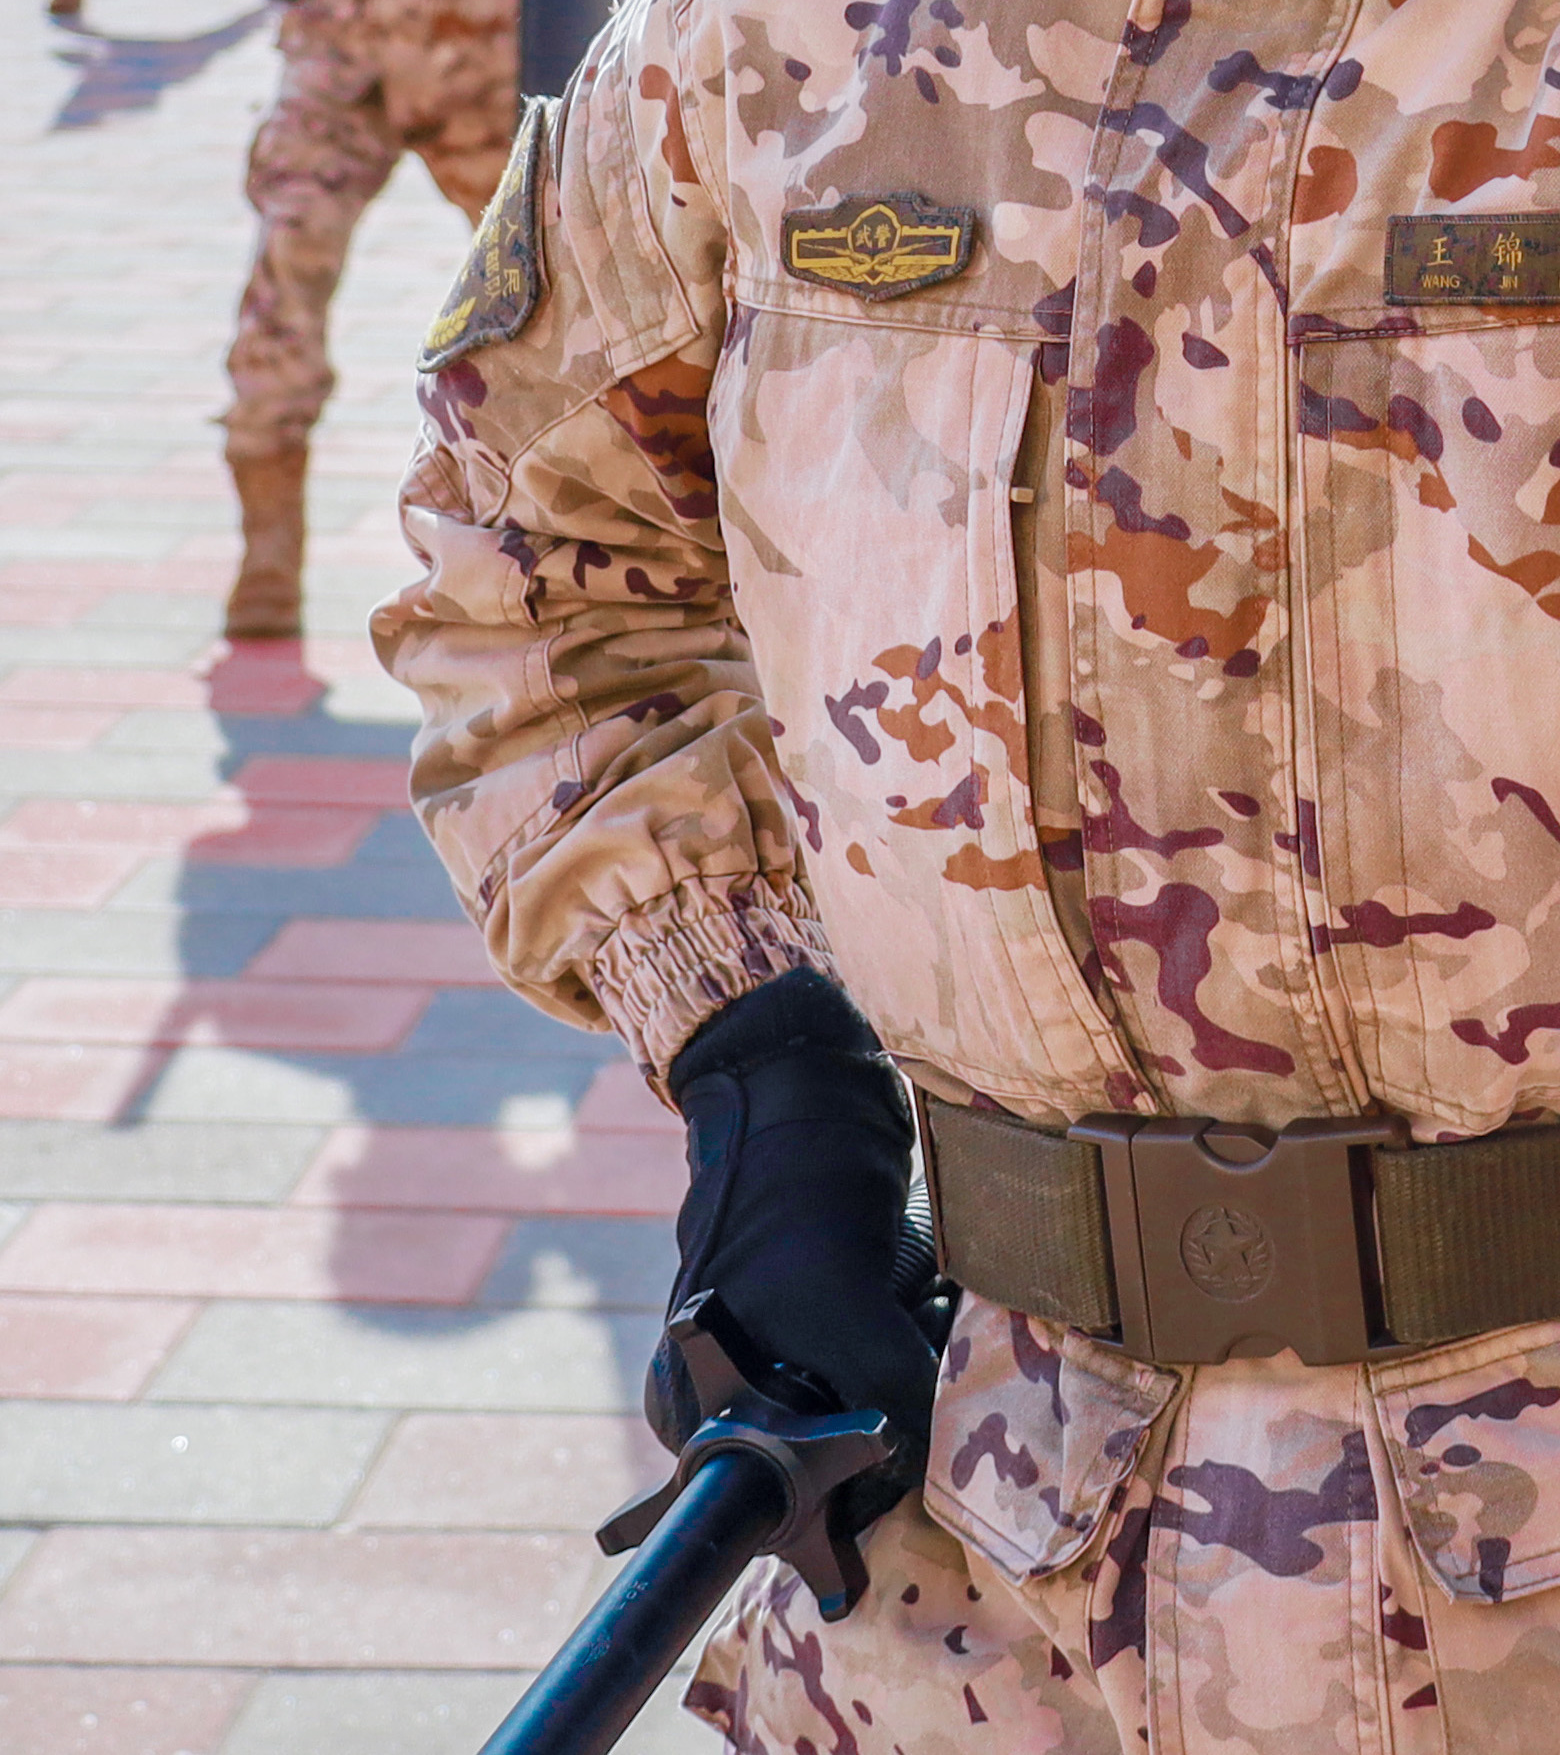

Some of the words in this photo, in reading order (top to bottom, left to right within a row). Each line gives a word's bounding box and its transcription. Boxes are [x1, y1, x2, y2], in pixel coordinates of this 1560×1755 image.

[855, 223, 892, 249] 武警
[1421, 274, 1460, 289] WANG
[1498, 274, 1519, 289] JIN
